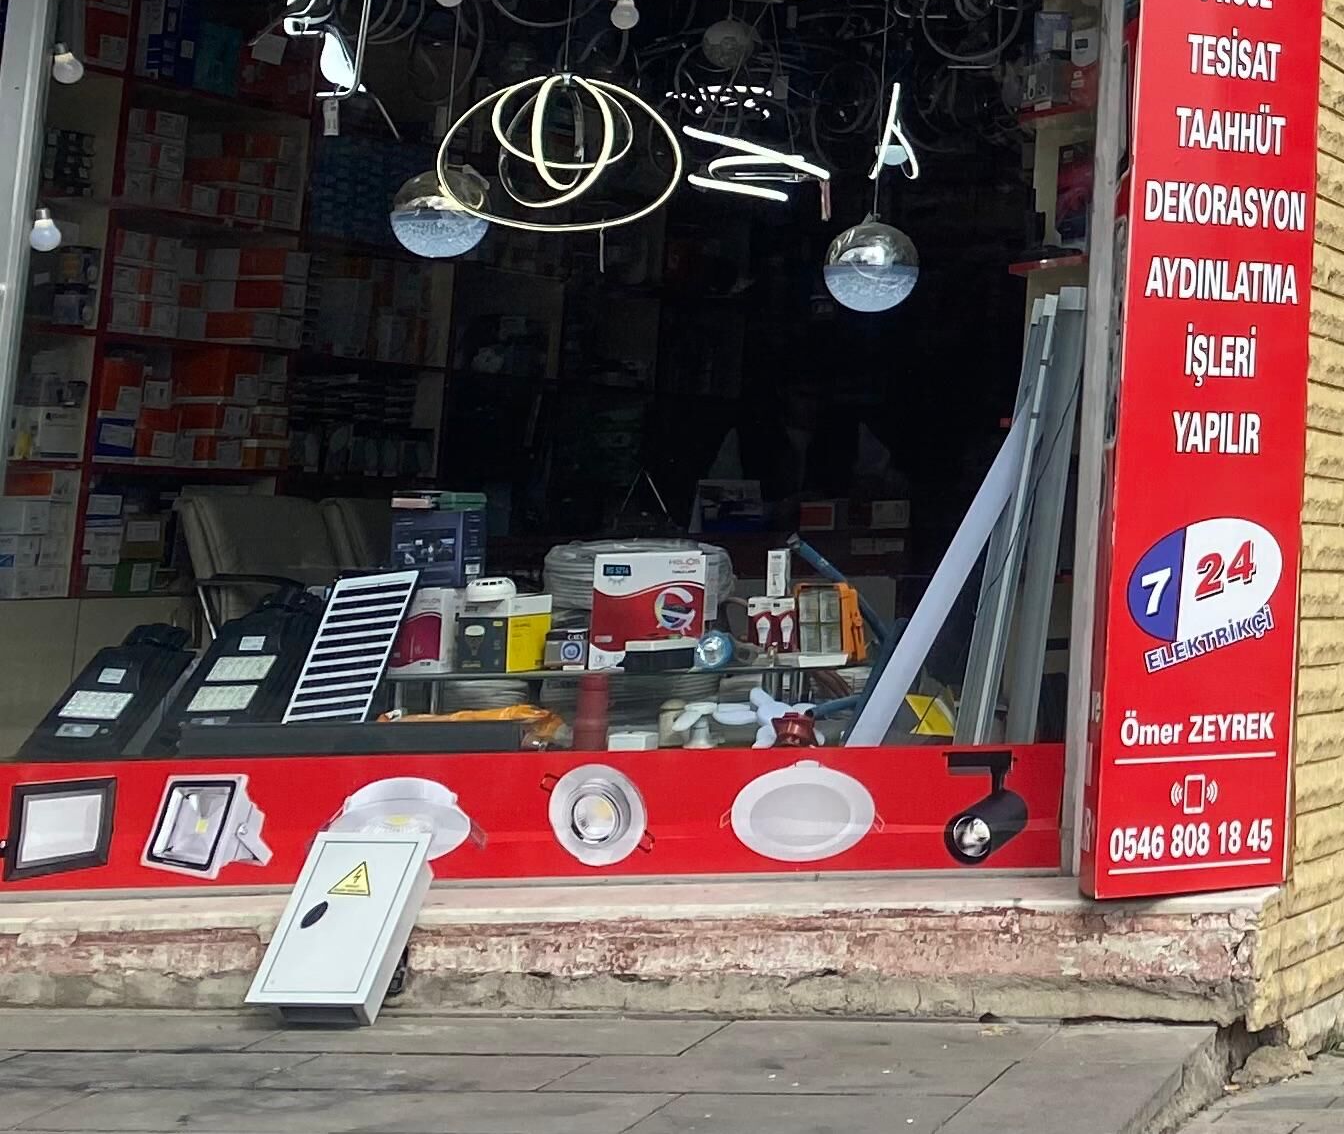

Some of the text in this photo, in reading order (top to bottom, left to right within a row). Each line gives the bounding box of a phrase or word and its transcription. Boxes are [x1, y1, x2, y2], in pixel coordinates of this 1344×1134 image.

[1187, 29, 1281, 83] TESİSAT
[1176, 105, 1286, 157] TAAHHÜT
[1144, 180, 1306, 232] DEKORASYON
[1145, 256, 1298, 305] AYDINLATMA
[1183, 325, 1257, 387] İŞLERİ
[1172, 411, 1260, 455] YAPILIR
[1140, 540, 1257, 617] 7 24
[1144, 603, 1274, 674] ELEKTRİKÇİ
[1120, 711, 1274, 746] Ömer ZEYREK
[1108, 818, 1273, 862] 0546 808 18 45
